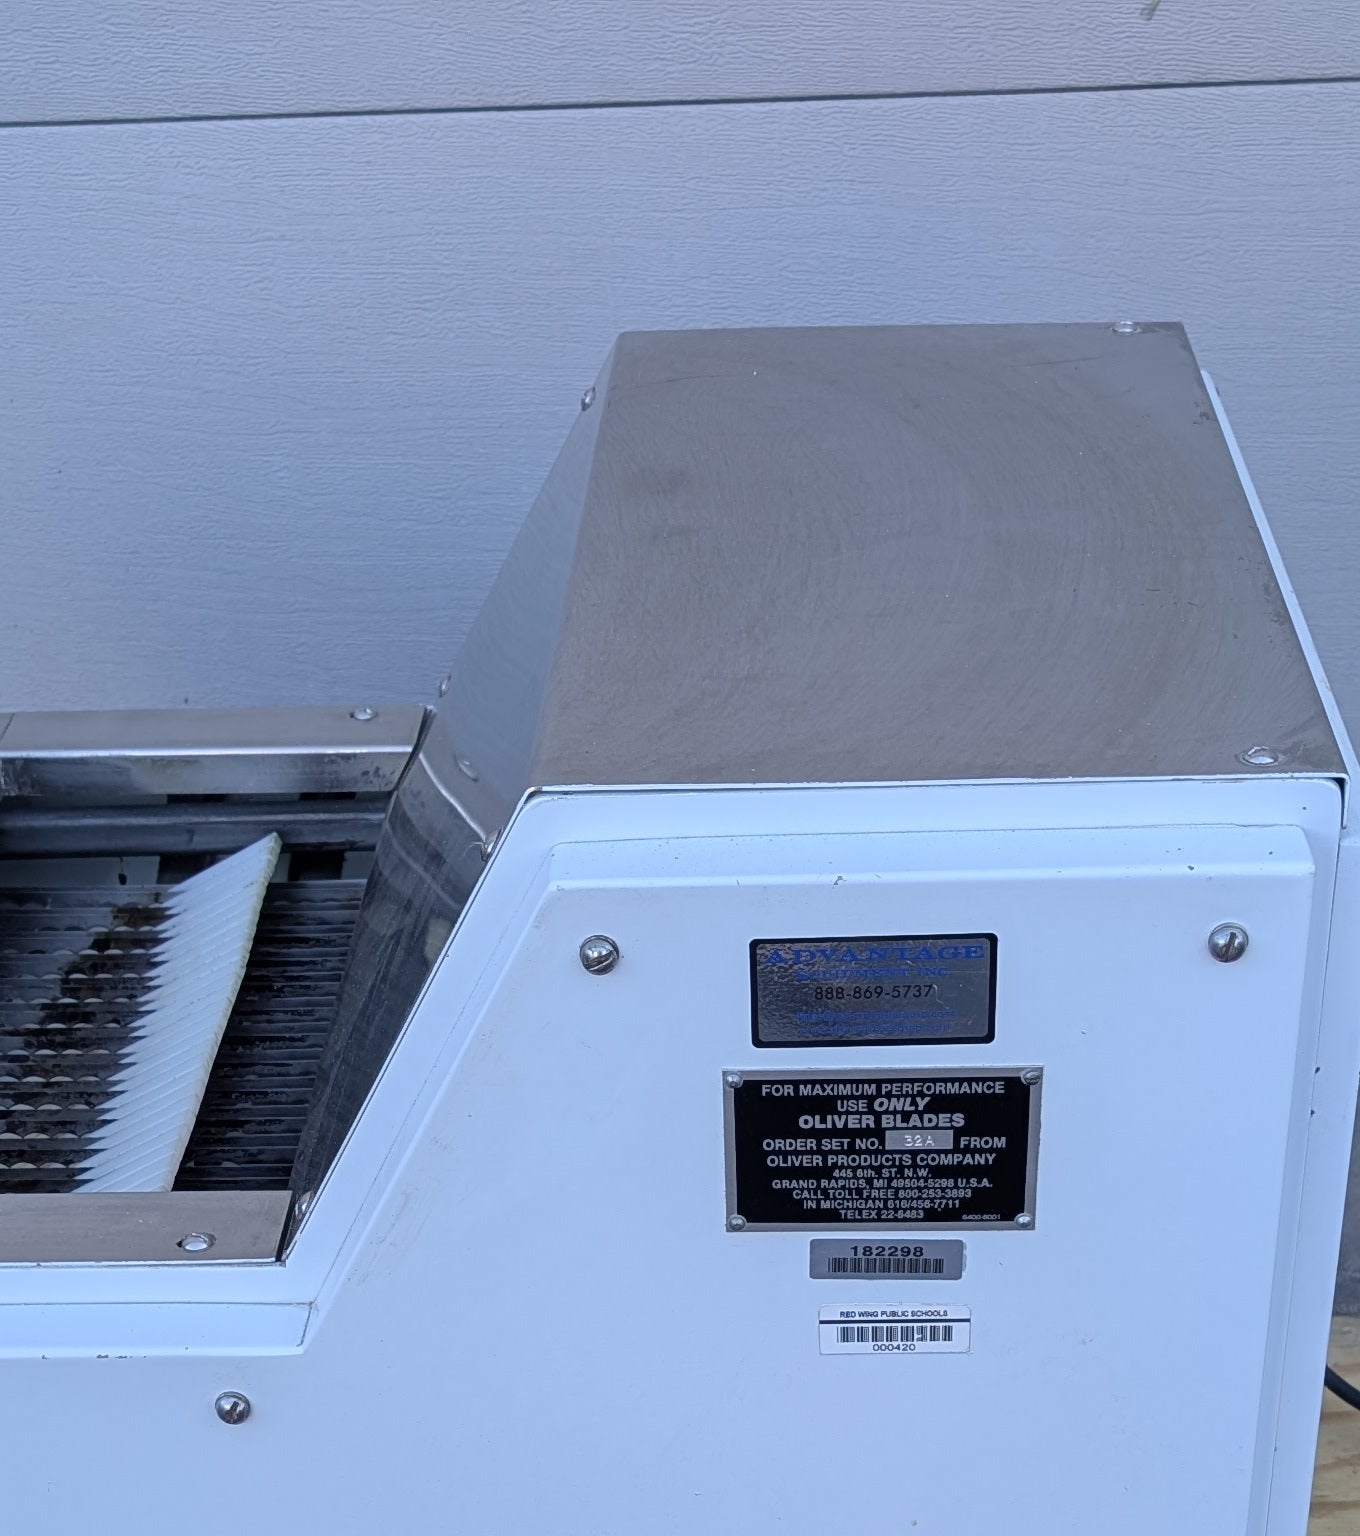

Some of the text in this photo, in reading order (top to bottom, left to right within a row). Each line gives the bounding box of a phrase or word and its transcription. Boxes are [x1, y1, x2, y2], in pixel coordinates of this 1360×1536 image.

[766, 946, 985, 964] ADVANTAGE
[814, 985, 933, 1001] 888-869-5737
[761, 1081, 1005, 1097] FOR MAXIMUM PERFORMANCE
[837, 1097, 932, 1112] USE ONLY
[798, 1113, 966, 1129] OLIVER BLADES
[762, 1135, 1007, 1151] ORDER SET NO. 32A FROM
[766, 1153, 997, 1167] OLIVER PRODUCTS COMPANY
[833, 1169, 854, 1178] 445
[881, 1168, 901, 1178] ST.
[904, 1168, 932, 1178] N.W.
[771, 1179, 817, 1189] GRAND
[820, 1179, 870, 1190] RAPIDS,
[873, 1179, 888, 1188] MI
[957, 1177, 993, 1188] U.S.A.
[792, 1188, 972, 1200] CALL TOLL FREE 800-253-3893
[803, 1199, 817, 1210] IN
[820, 1199, 884, 1210] MICHIGAN
[839, 1210, 879, 1220] TELEX
[849, 1245, 924, 1258] 182298
[839, 1310, 856, 1319] RED
[881, 1310, 909, 1318] PUBLIC
[910, 1309, 949, 1317] SCHOOLS
[872, 1343, 917, 1352] 000420
